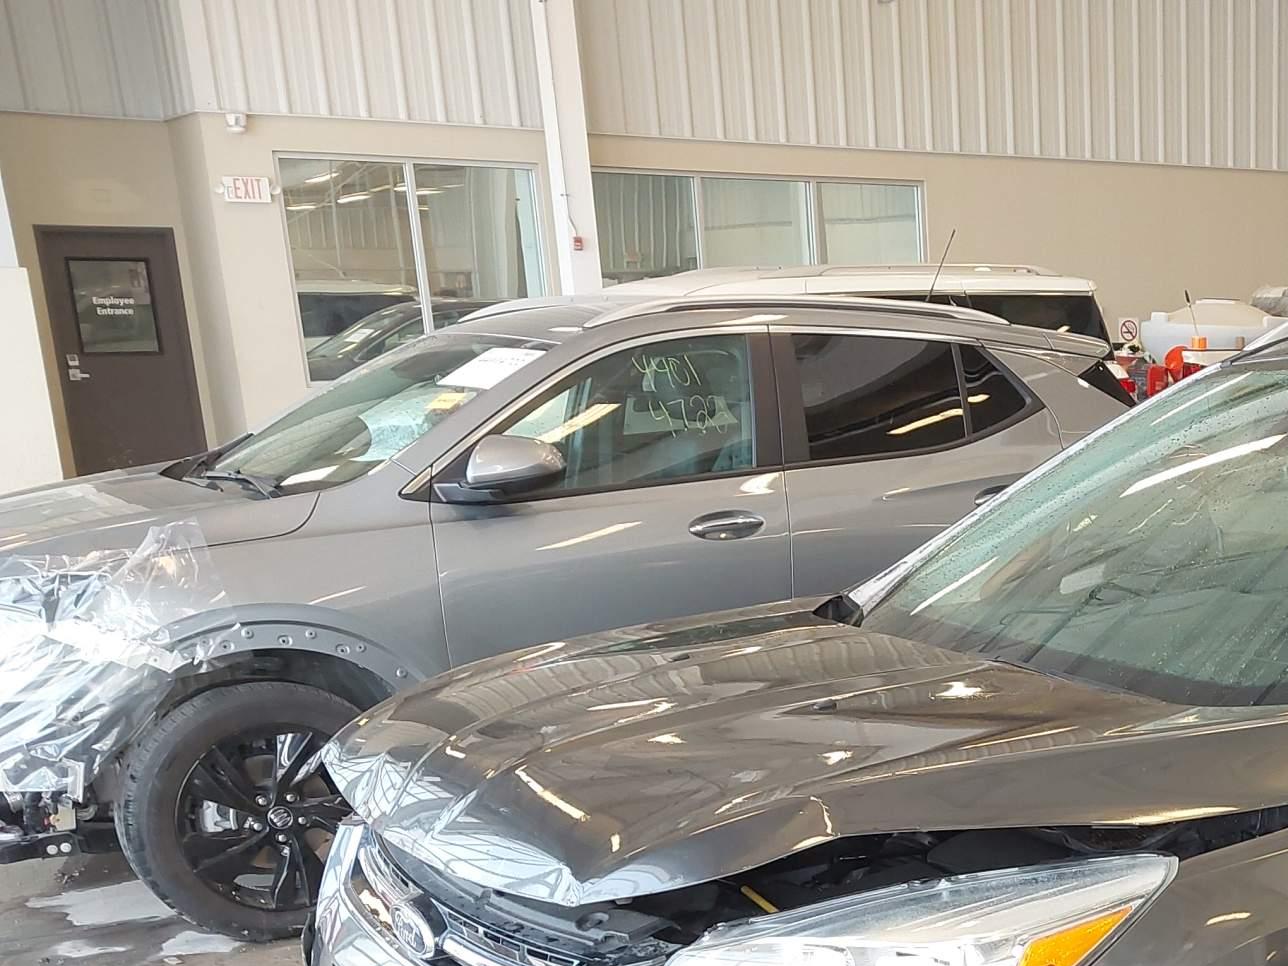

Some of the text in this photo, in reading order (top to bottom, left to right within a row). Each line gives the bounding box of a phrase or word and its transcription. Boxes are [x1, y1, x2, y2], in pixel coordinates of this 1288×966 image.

[233, 178, 262, 199] EXIT
[92, 296, 135, 306] Employee
[96, 306, 135, 316] Entrance
